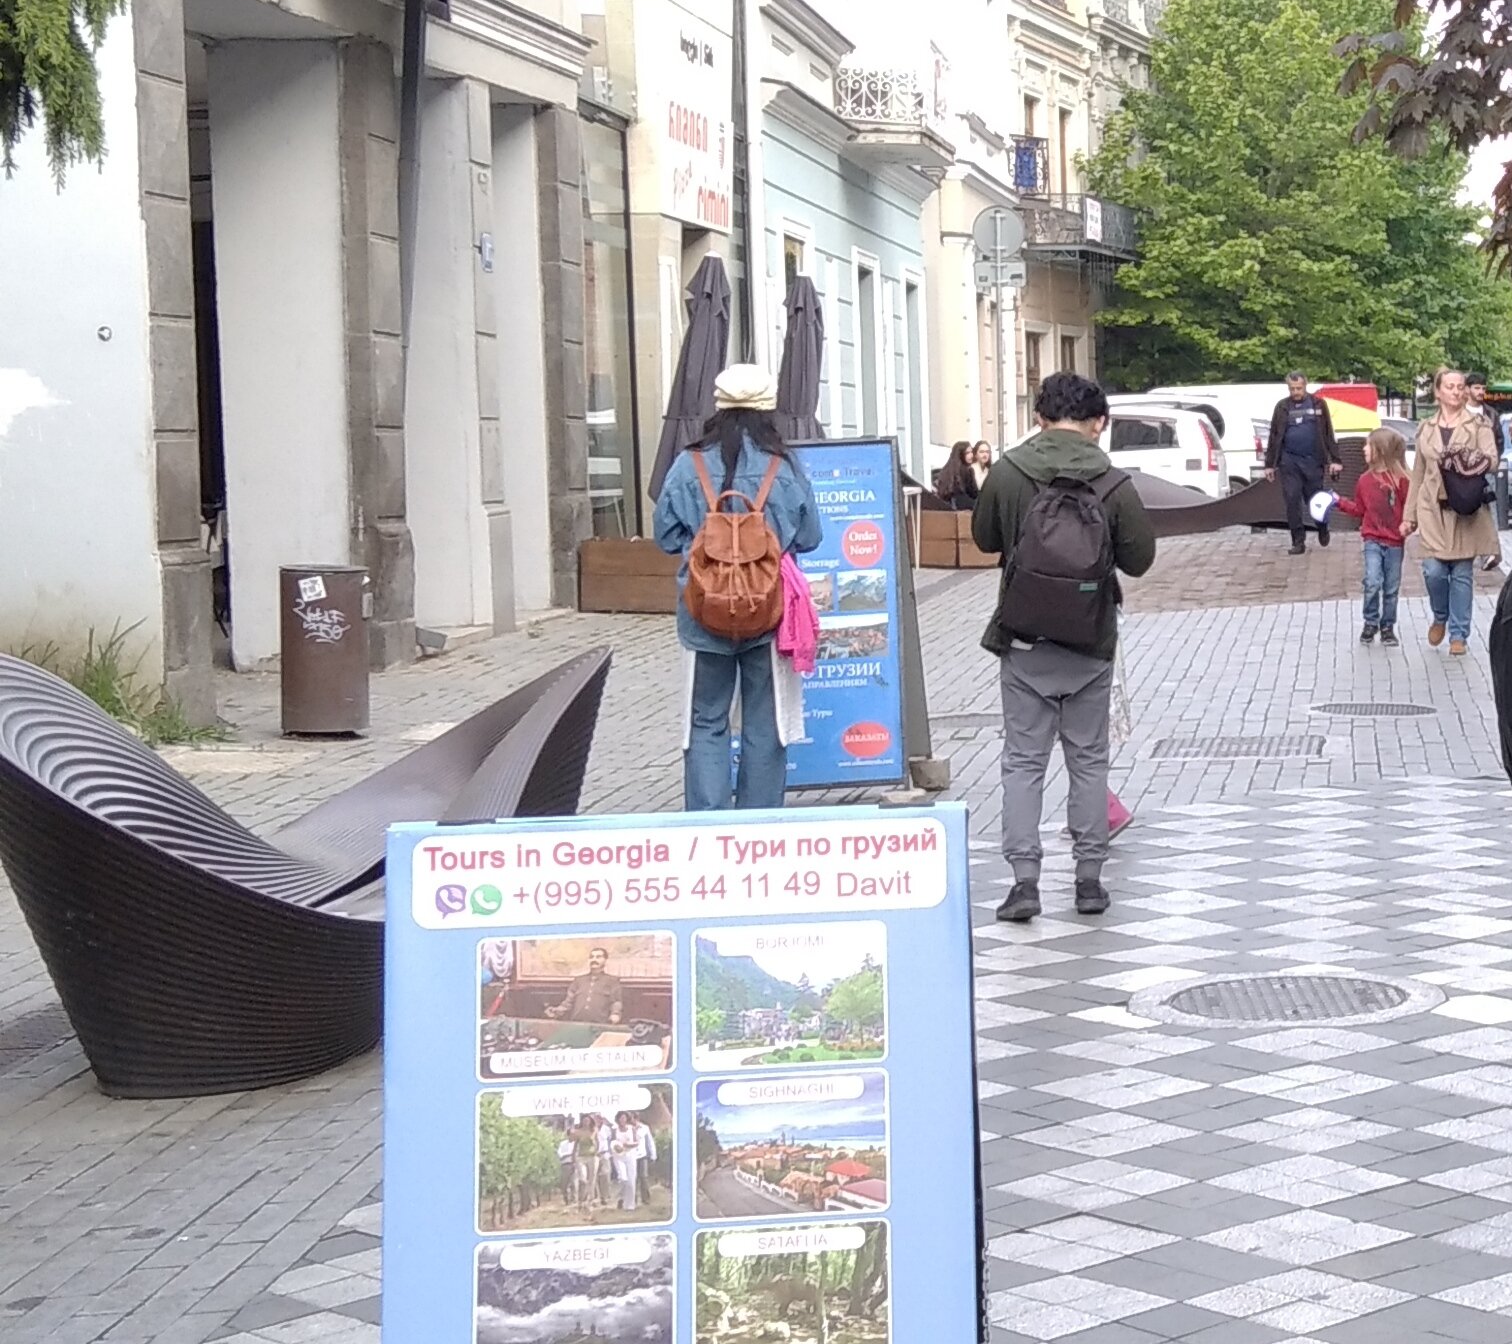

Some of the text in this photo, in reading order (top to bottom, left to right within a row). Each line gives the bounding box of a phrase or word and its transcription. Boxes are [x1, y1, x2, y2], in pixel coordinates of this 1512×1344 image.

[697, 176, 729, 228] rimini
[849, 531, 877, 541] Order
[850, 544, 878, 556] Now!
[818, 661, 881, 679] ГРУЗИИ
[803, 679, 867, 690] АПРАВЛЕНИЯМ
[423, 846, 505, 871] Tours
[517, 844, 541, 868] in
[552, 839, 670, 869] Georgia
[716, 835, 786, 864] Тури
[797, 837, 831, 856] по
[841, 827, 937, 860] грузий
[512, 870, 911, 913] +(995) 555 44 11 49 Davit
[501, 1054, 566, 1068] MUSEUM
[595, 1050, 646, 1063] STALIN
[533, 1094, 620, 1110] WINE TOUR
